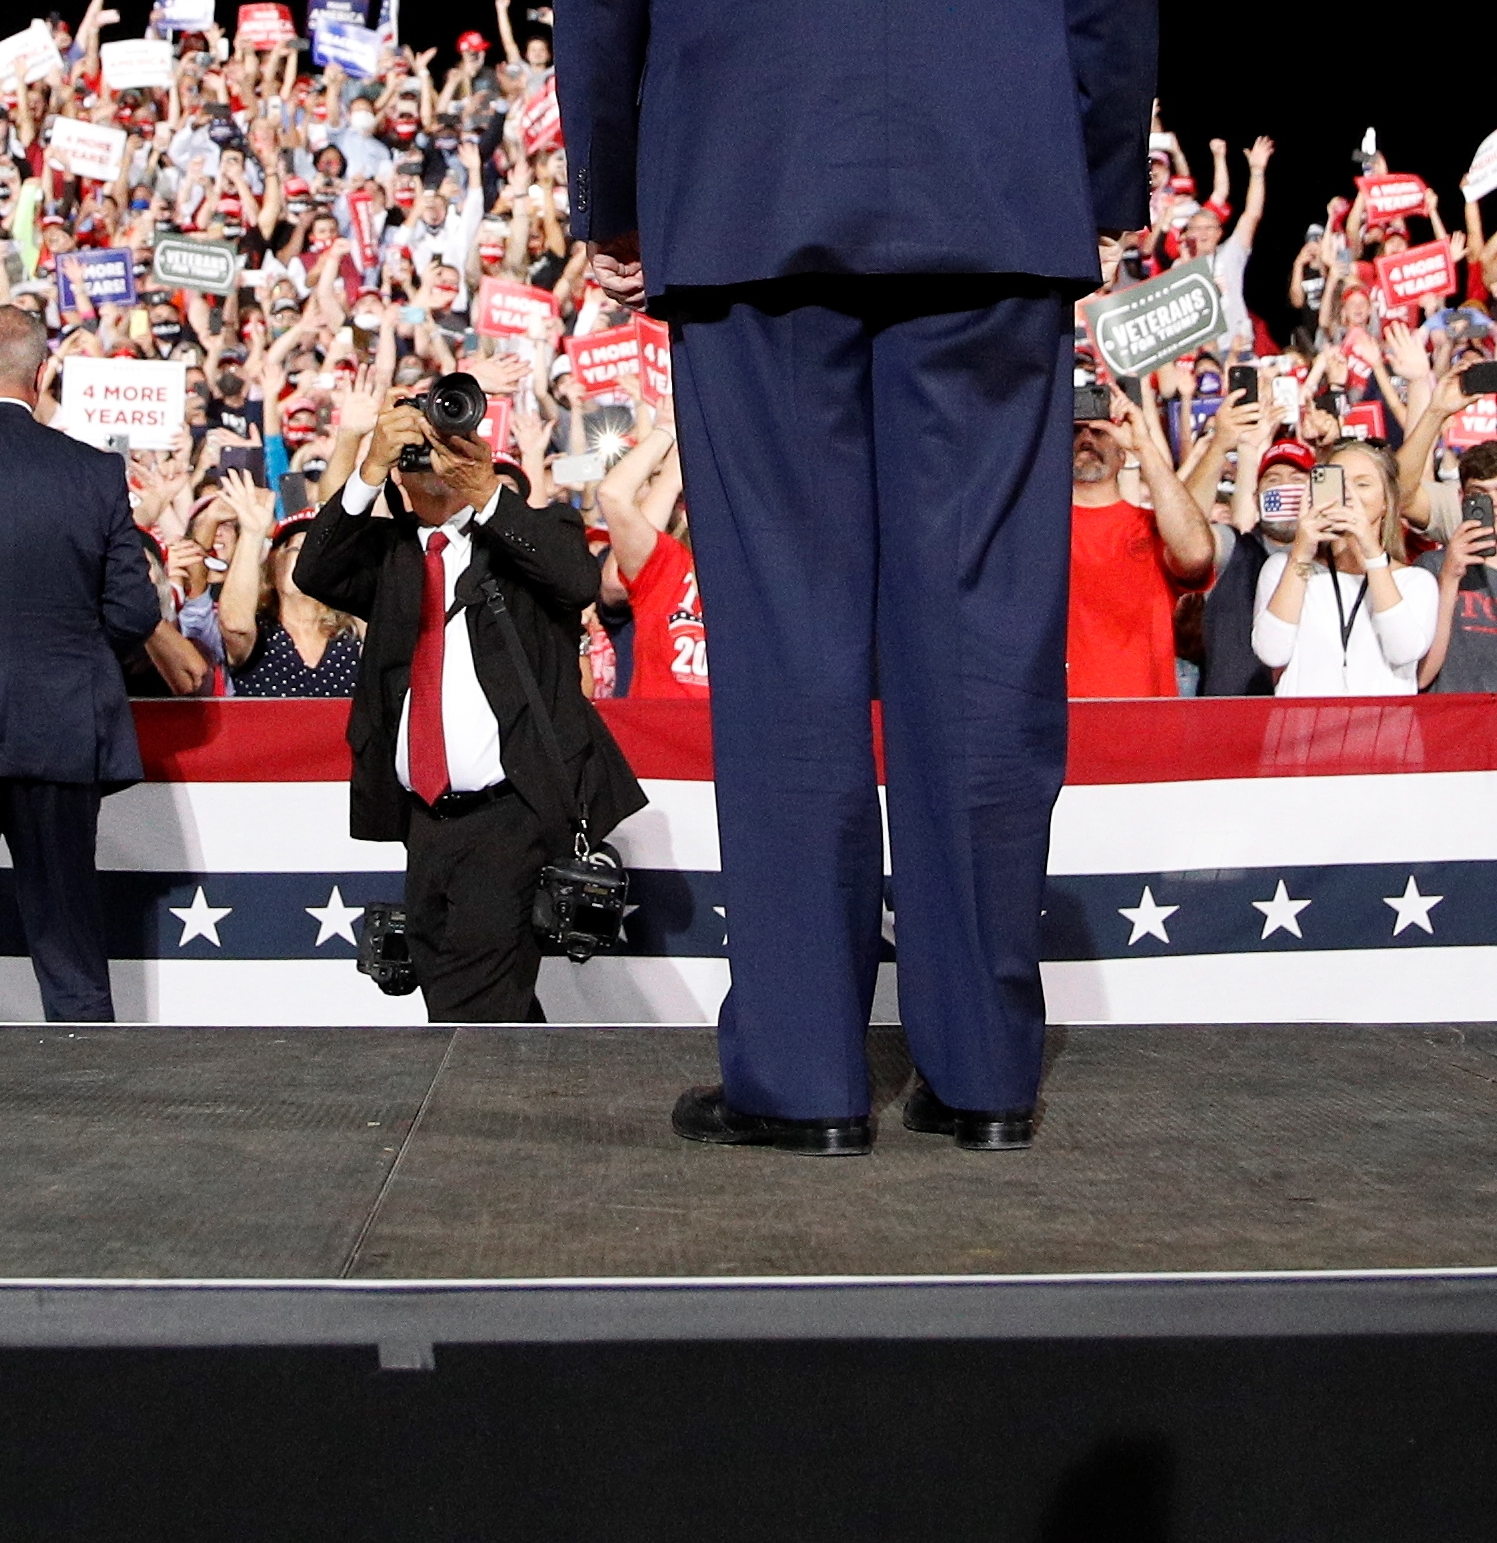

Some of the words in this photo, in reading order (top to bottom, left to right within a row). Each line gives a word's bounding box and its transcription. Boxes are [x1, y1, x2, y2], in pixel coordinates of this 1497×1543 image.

[1370, 185, 1380, 197] 4
[1380, 181, 1420, 197] MORE
[164, 249, 228, 273] VETERANS
[1389, 267, 1402, 281] 4
[1403, 254, 1446, 278] MORE
[1393, 270, 1448, 297] YEARS!
[490, 293, 503, 307] 4
[503, 294, 551, 317] MORE
[1111, 288, 1206, 346] VETERANS
[1130, 334, 1153, 356] FOR
[1157, 310, 1200, 340] TRUMP
[578, 351, 592, 366] 4
[83, 385, 94, 399] 4
[104, 386, 168, 402] MORE
[84, 409, 164, 427] YEARS!
